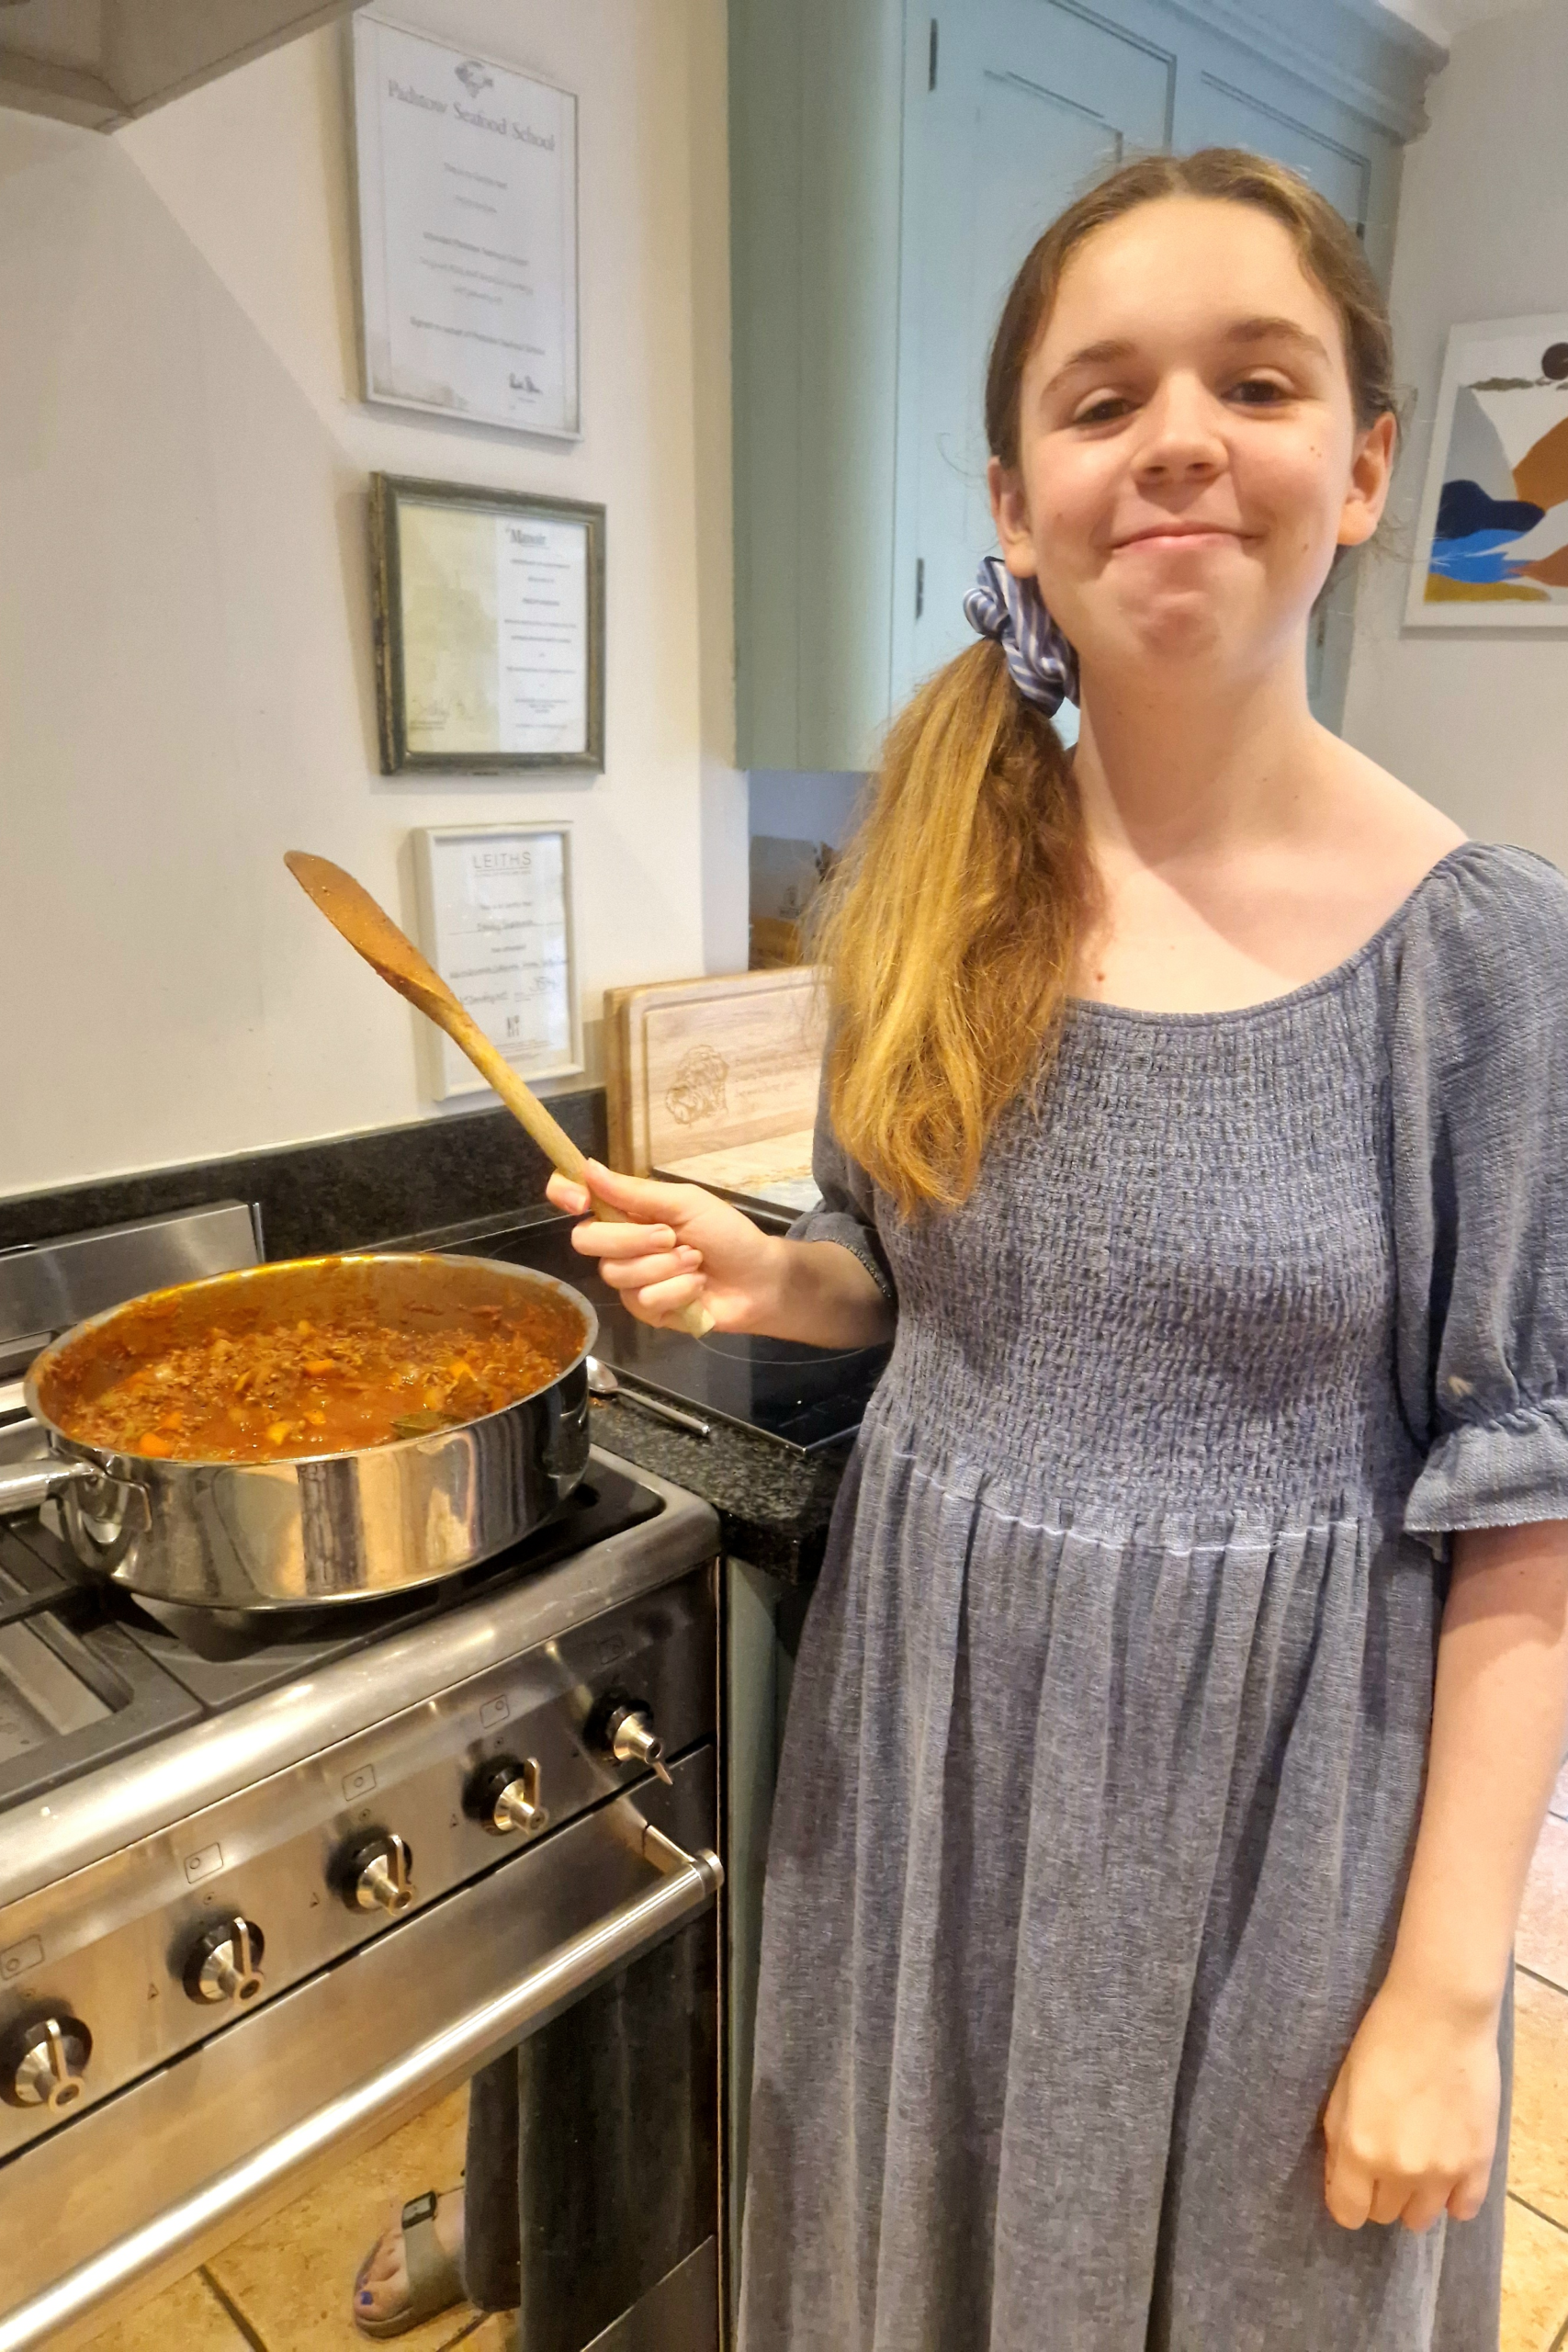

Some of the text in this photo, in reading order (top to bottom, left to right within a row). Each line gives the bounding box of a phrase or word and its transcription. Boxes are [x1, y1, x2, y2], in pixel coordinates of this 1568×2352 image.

[454, 101, 506, 135] Seafood
[513, 121, 555, 152] School
[473, 851, 532, 869] LEITHS
